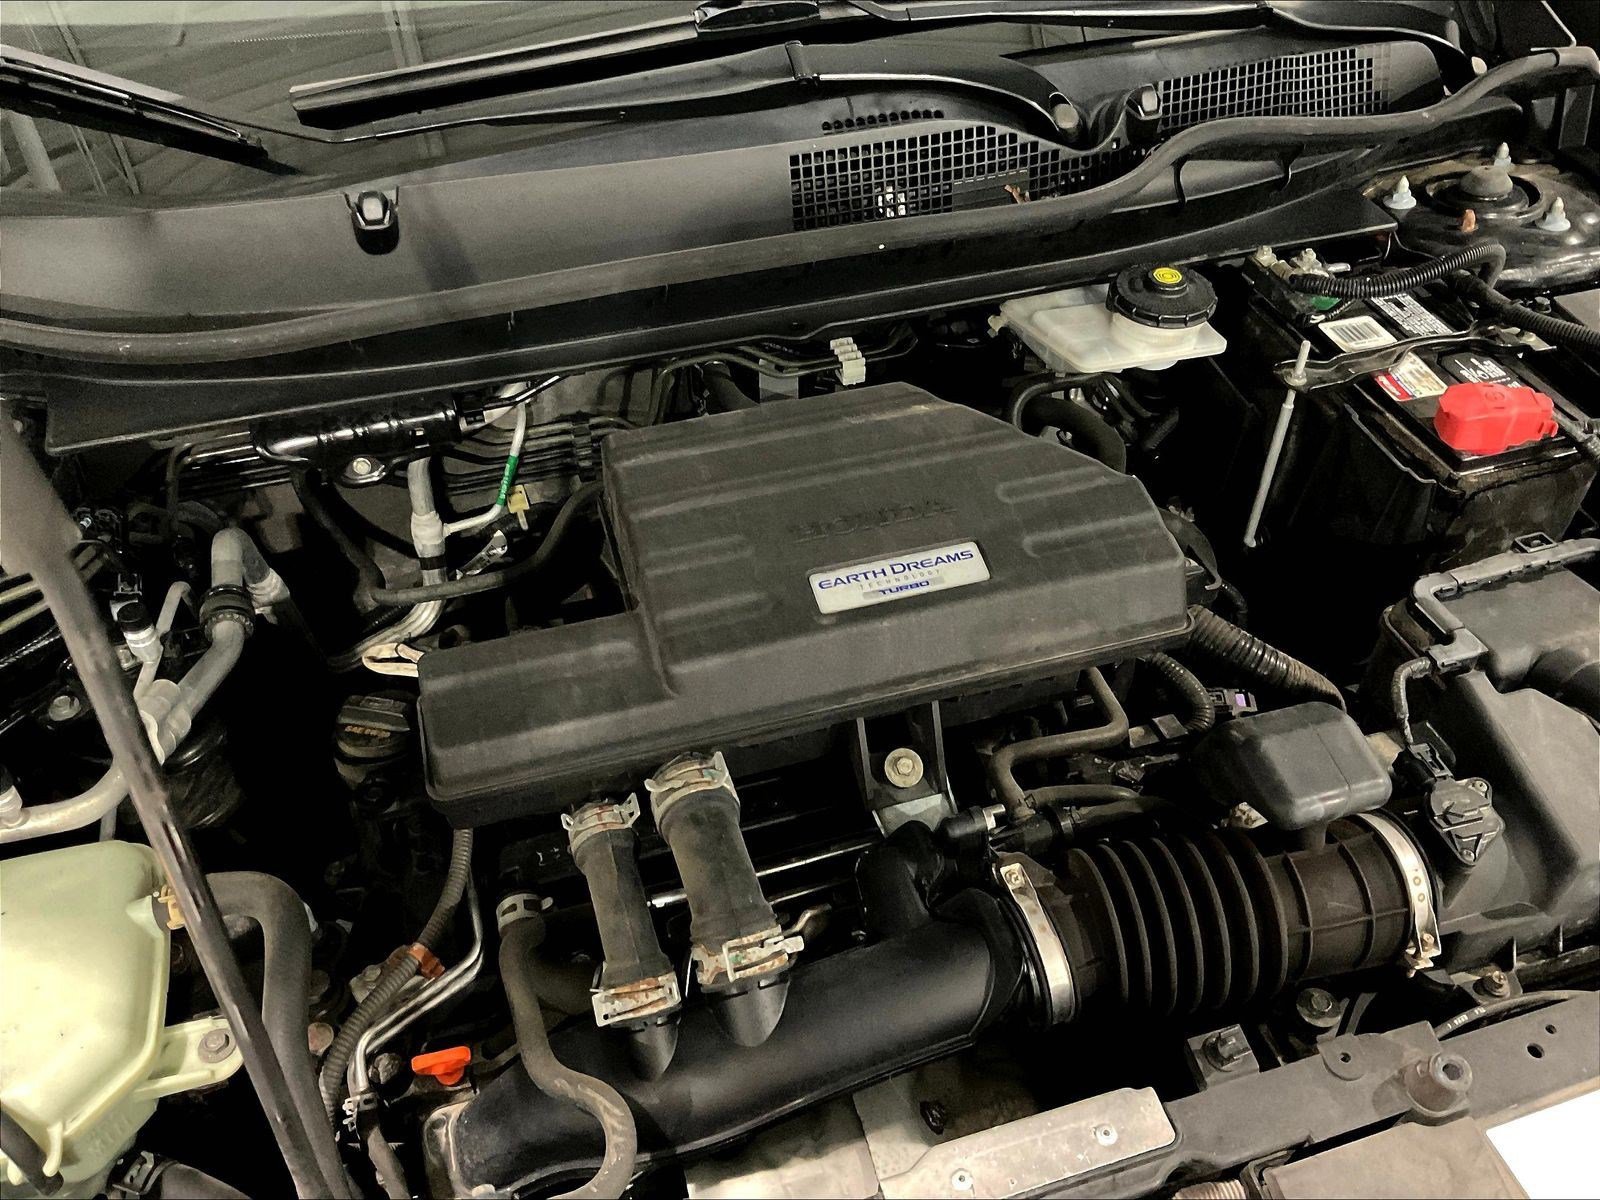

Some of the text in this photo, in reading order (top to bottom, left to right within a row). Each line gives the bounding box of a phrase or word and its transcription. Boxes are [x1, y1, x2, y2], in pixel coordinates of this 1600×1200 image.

[818, 550, 974, 590] EARTH DREAMS
[858, 569, 941, 591] TECHNOLOGY
[877, 580, 930, 596] TURBO
